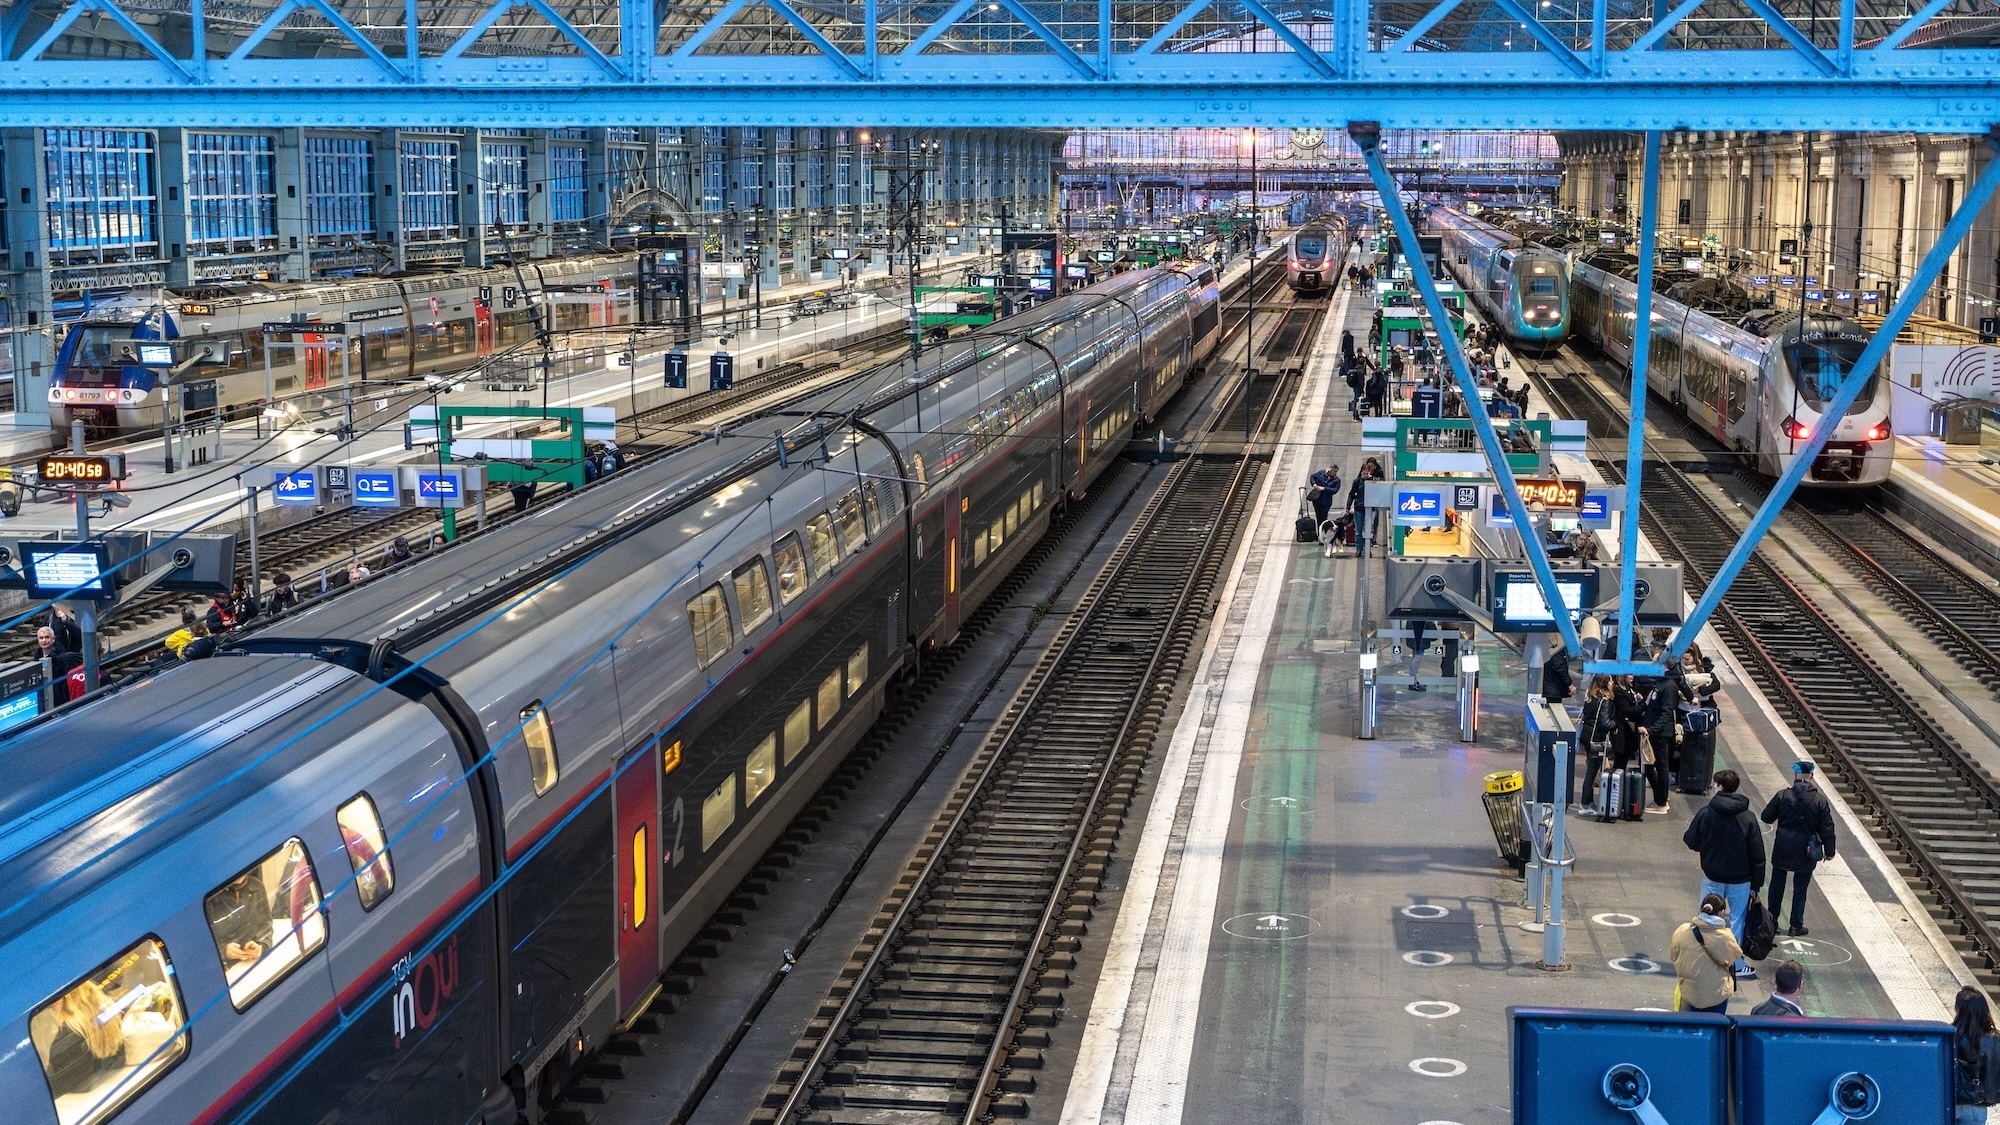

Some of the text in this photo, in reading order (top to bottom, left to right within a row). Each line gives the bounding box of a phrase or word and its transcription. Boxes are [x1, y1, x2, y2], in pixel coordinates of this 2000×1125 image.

[481, 290, 490, 300] U
[505, 290, 514, 301] U
[1984, 322, 1994, 334] U
[670, 360, 682, 376] T
[716, 362, 728, 378] T
[1420, 400, 1434, 418] T
[46, 462, 86, 478] 20:40
[672, 796, 684, 869] 2
